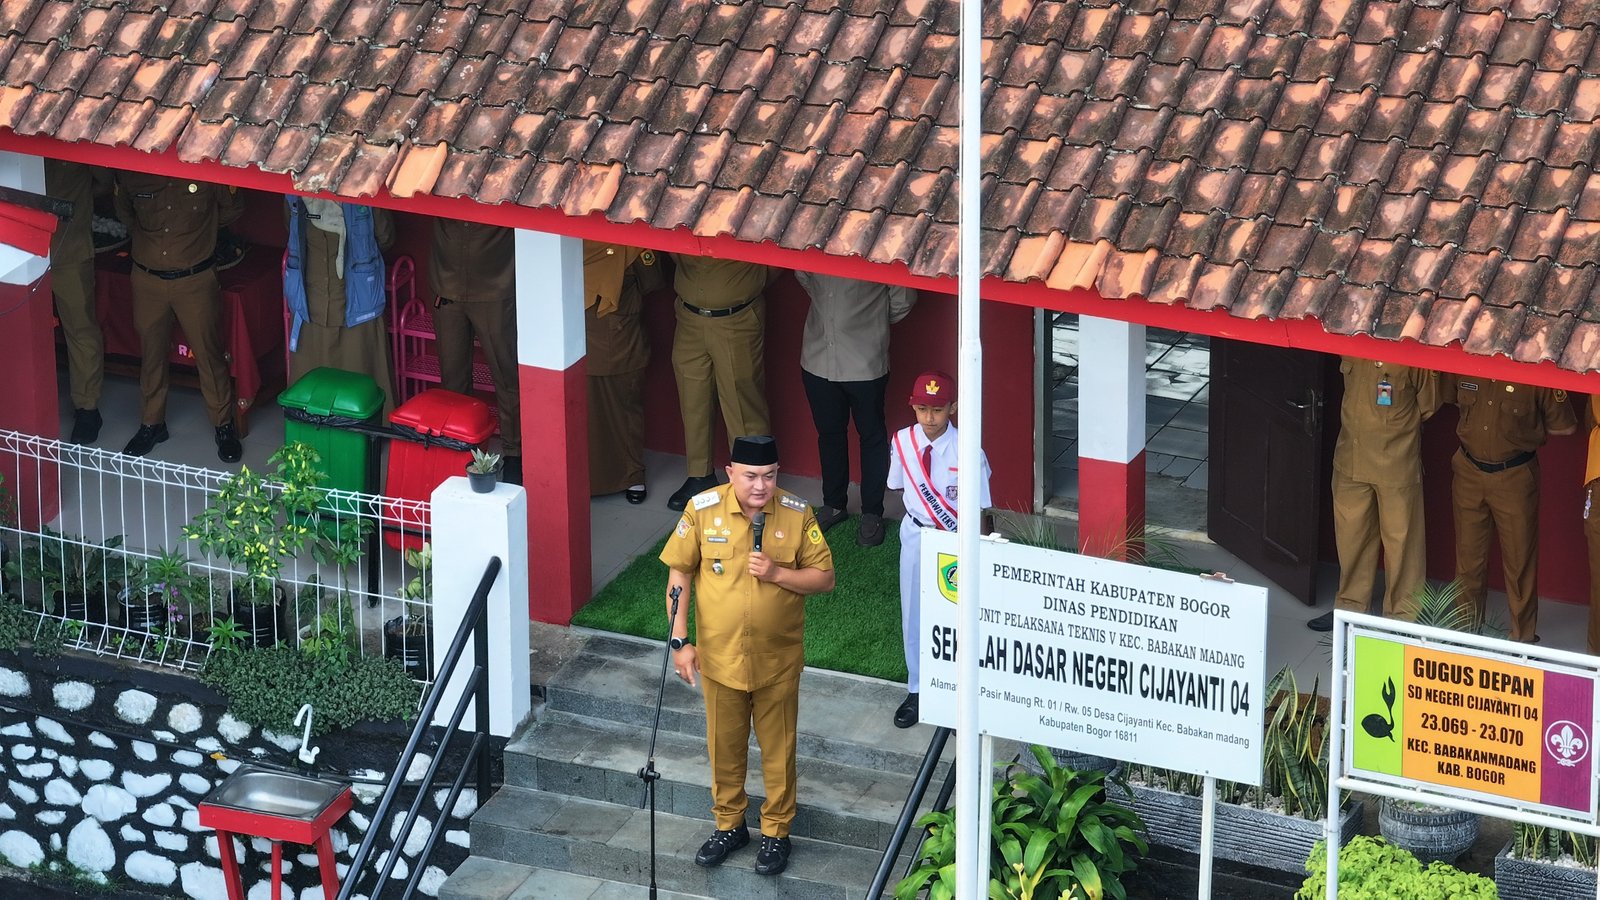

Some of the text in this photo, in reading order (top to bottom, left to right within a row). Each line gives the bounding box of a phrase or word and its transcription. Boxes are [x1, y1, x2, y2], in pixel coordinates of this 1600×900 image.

[919, 483, 955, 528] PEMBAWA TEKS
[993, 563, 1230, 619] PEMERINTAH KABUPATEN BOGOR
[1043, 596, 1177, 632] DINAS PENDIDIKAN
[1004, 612, 1064, 636] PELAKSANA
[1068, 624, 1105, 643] TEKNIS
[1109, 631, 1116, 645] V
[1119, 633, 1143, 650] KEC.
[1147, 638, 1196, 659] BABAKAN
[1200, 648, 1245, 668] MADANG
[1013, 640, 1066, 683] DASAR
[1073, 651, 1133, 695] NEGERI
[1139, 663, 1224, 712] CIJAYANTI
[1231, 680, 1249, 716] 04
[1413, 658, 1534, 698] GUGUS DEPAN
[930, 677, 957, 691] Alama
[1004, 691, 1031, 708] Maung
[1034, 696, 1045, 708] Rt.
[1047, 699, 1056, 710] 01
[1065, 702, 1079, 714] Rw.
[1082, 706, 1092, 717] 05
[1094, 708, 1114, 721] Desa
[1117, 712, 1153, 728] Cijayanti
[1156, 719, 1174, 732] Kec.
[1177, 723, 1213, 739] Babakan
[1216, 733, 1249, 749] madang
[1408, 684, 1538, 721] SD NEGERI CIJAYANTI 04
[1039, 715, 1137, 742] Kabupaten Bogor 16811
[1421, 713, 1468, 735] 23.069
[1480, 723, 1523, 746] 23.070
[1407, 737, 1536, 774] KEC. BABAKANMADANG
[1438, 761, 1505, 785] KAB. BOGOR
